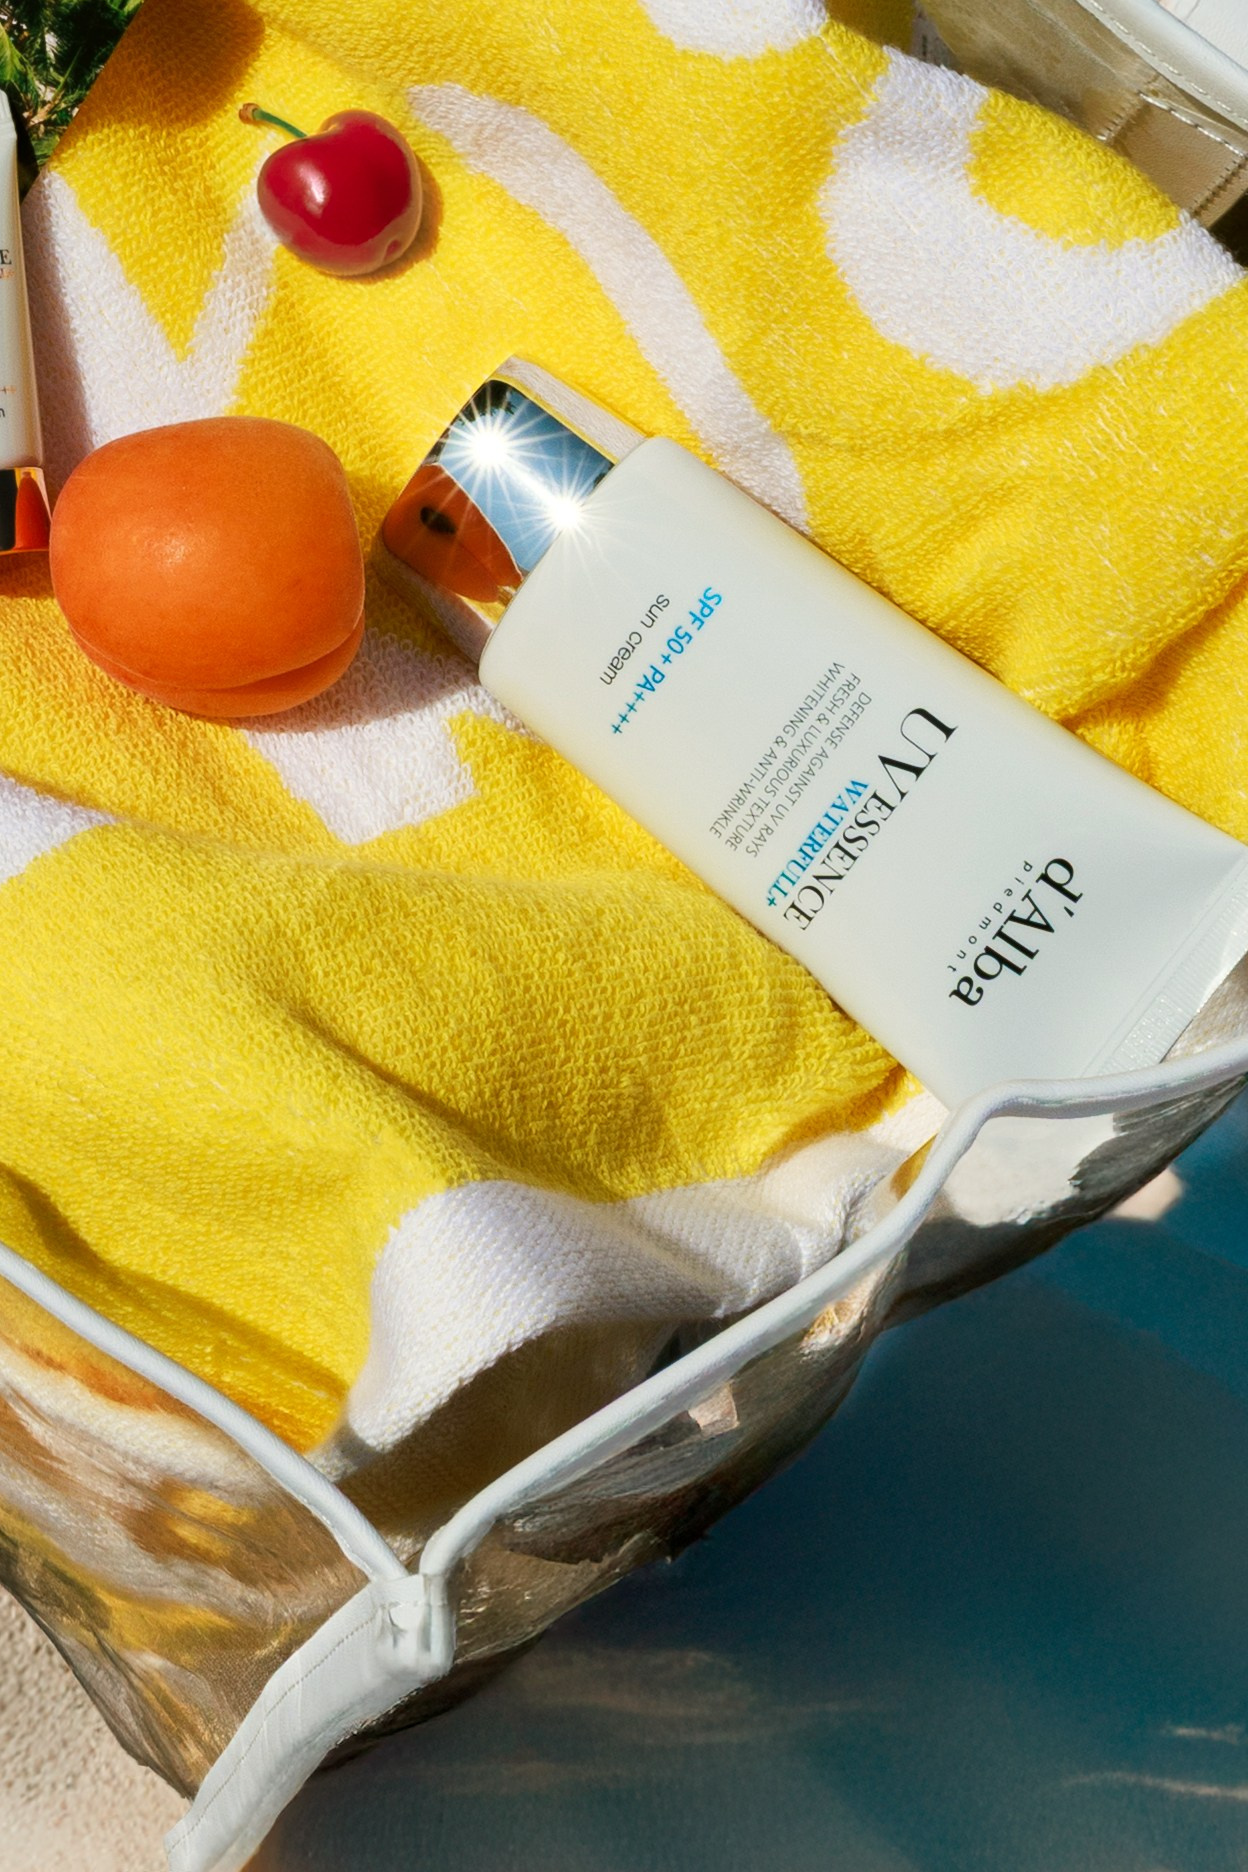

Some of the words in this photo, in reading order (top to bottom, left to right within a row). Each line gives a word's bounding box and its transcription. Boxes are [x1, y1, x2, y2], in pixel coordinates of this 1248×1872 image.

[640, 594, 670, 628] sun
[688, 586, 723, 631] SPF
[600, 631, 643, 685] cream
[661, 625, 693, 665] 50+
[611, 664, 666, 734] PA++++
[782, 662, 846, 738] WHITENING
[816, 712, 831, 727] &
[825, 672, 861, 716] FRESH
[825, 691, 872, 750] DEFENSE
[764, 724, 822, 798] LUXURIOUS
[773, 735, 788, 749] &
[878, 707, 959, 803] UV
[709, 746, 778, 839] ANTI-WRINKLE
[788, 746, 830, 807] AGAINST
[724, 796, 772, 852] TEXTURE
[745, 822, 775, 858] RAYS
[766, 779, 870, 907] WATERFULL+
[771, 802, 790, 827] UV
[783, 789, 898, 931] ESSENCE
[947, 860, 1033, 972] piedmont
[948, 858, 1083, 1006] d'Alba
